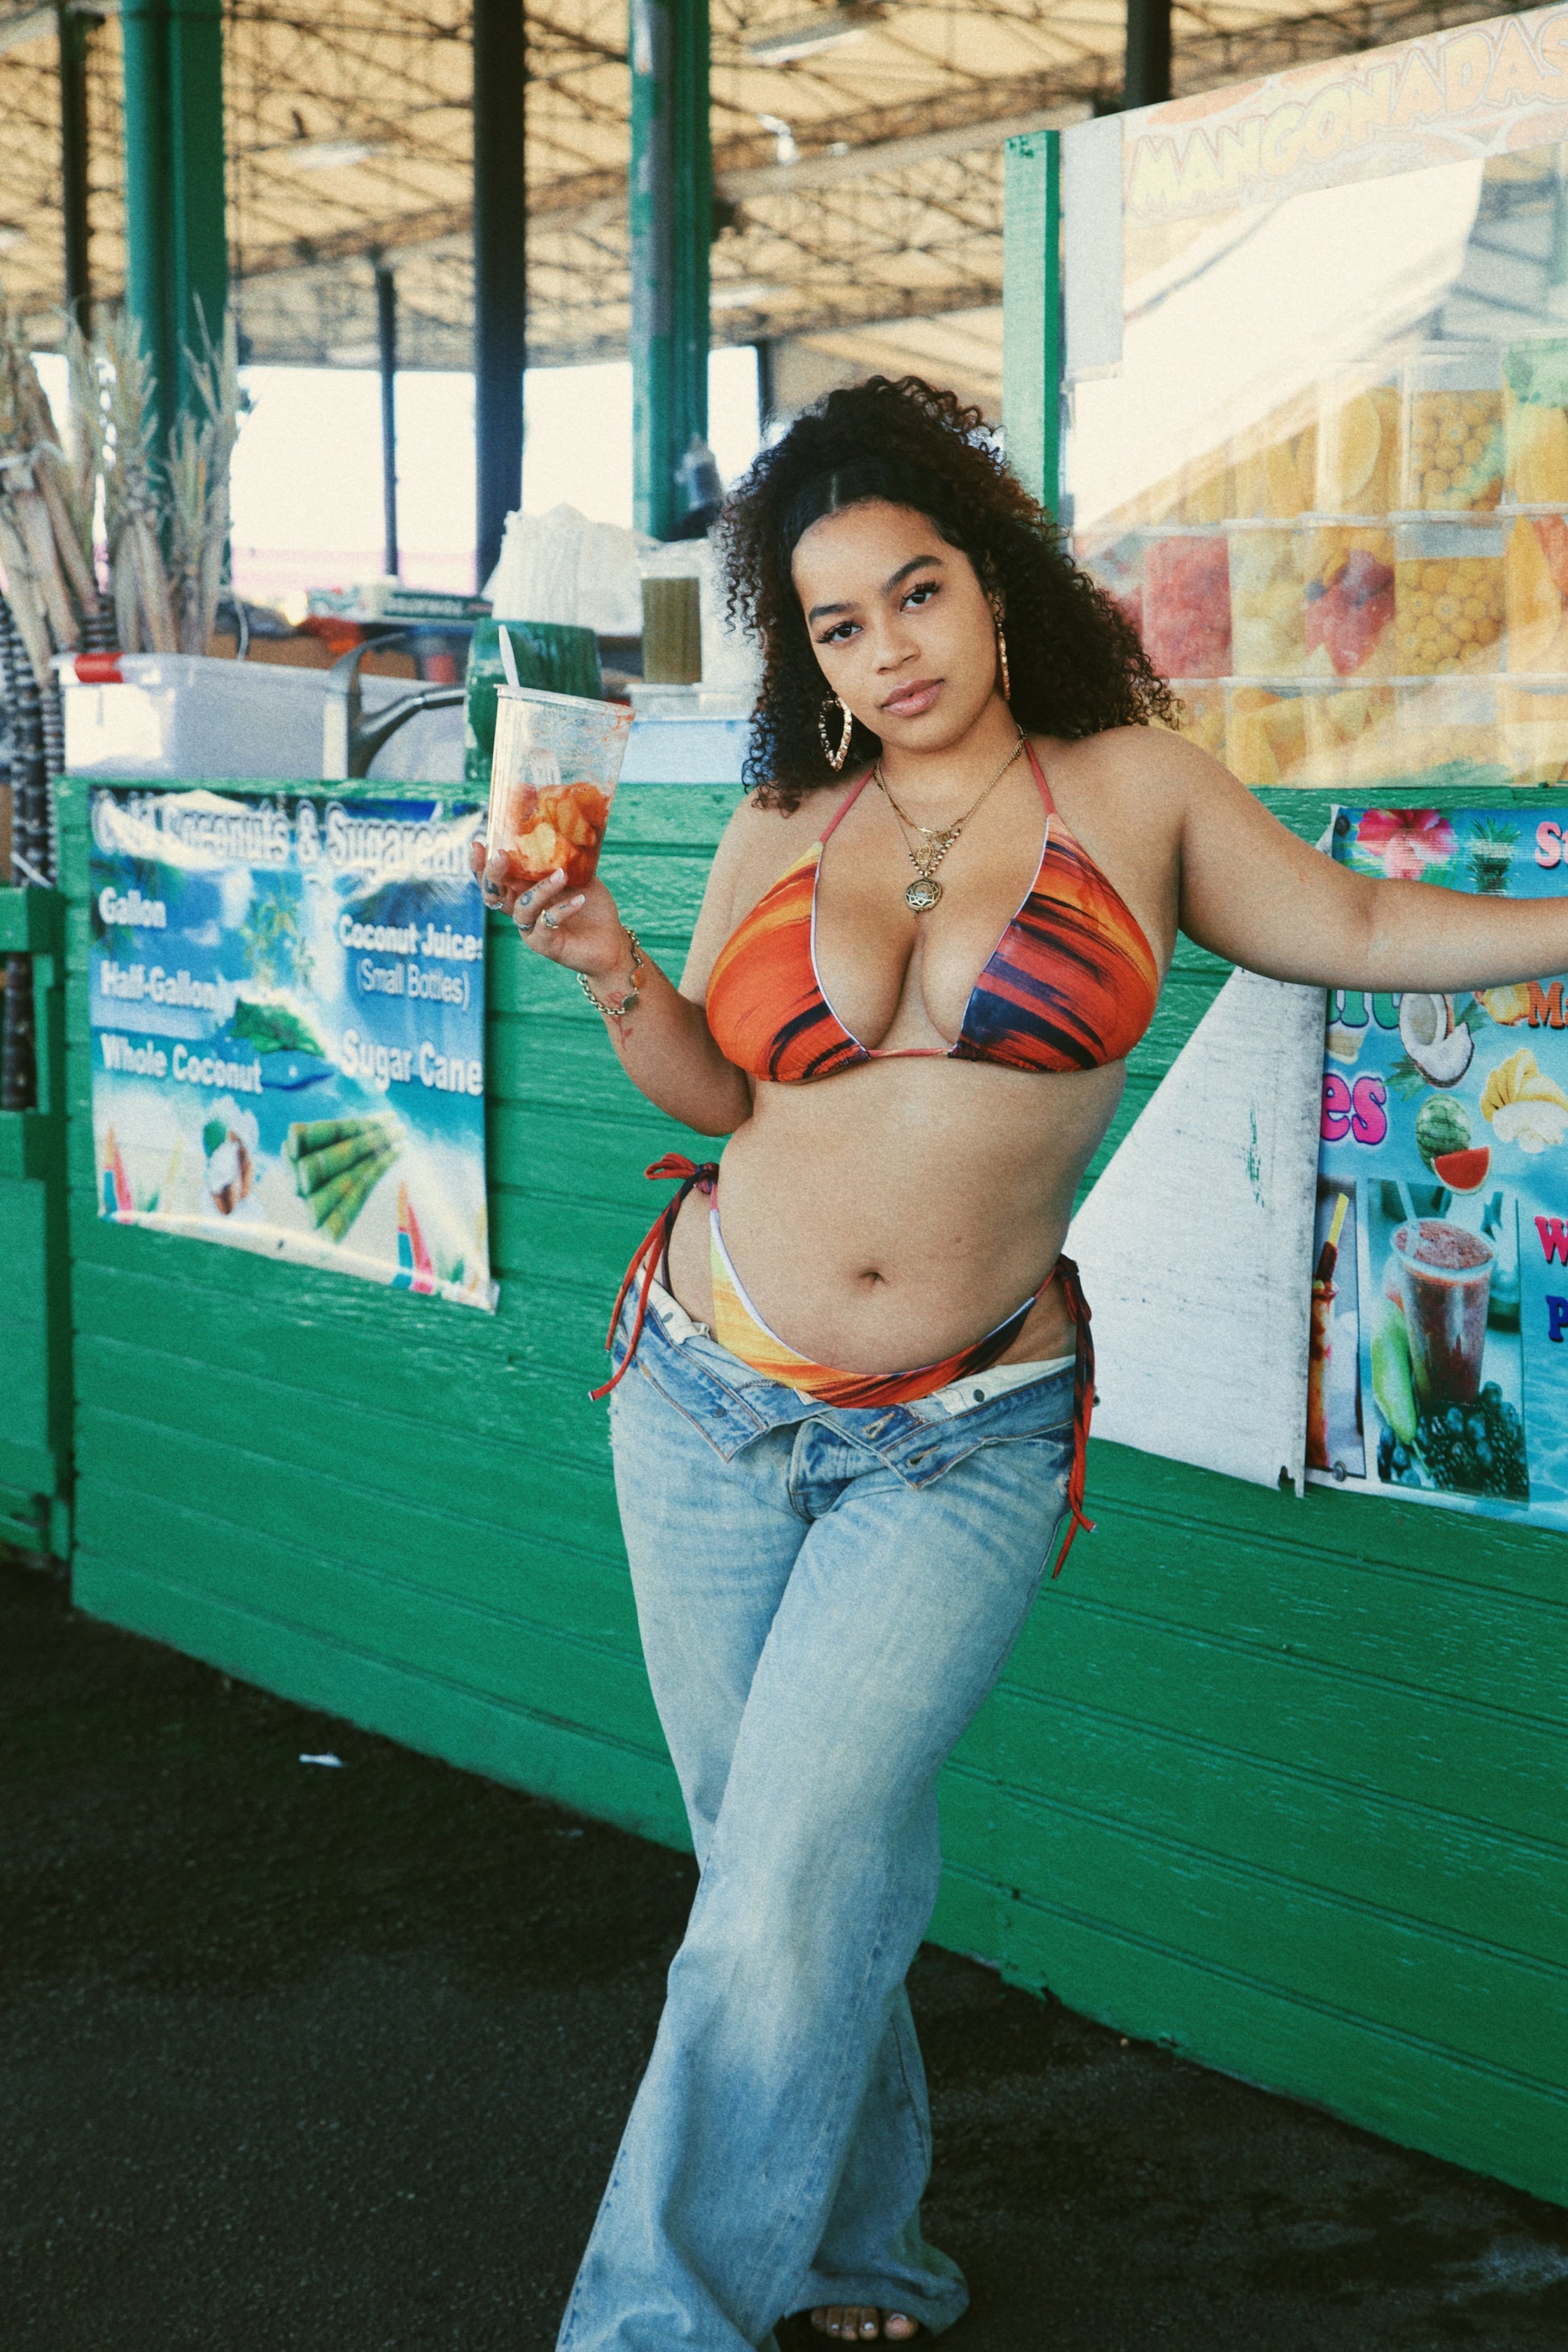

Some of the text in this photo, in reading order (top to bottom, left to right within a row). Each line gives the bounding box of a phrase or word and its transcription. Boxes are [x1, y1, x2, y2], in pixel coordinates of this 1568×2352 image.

[297, 799, 321, 865] &
[98, 886, 167, 929] Gallon
[339, 913, 418, 956] Coconut
[100, 959, 217, 1009] Half-Gallon
[100, 1032, 263, 1095] Whole Coconut
[342, 1028, 483, 1097] Sugar Cane
